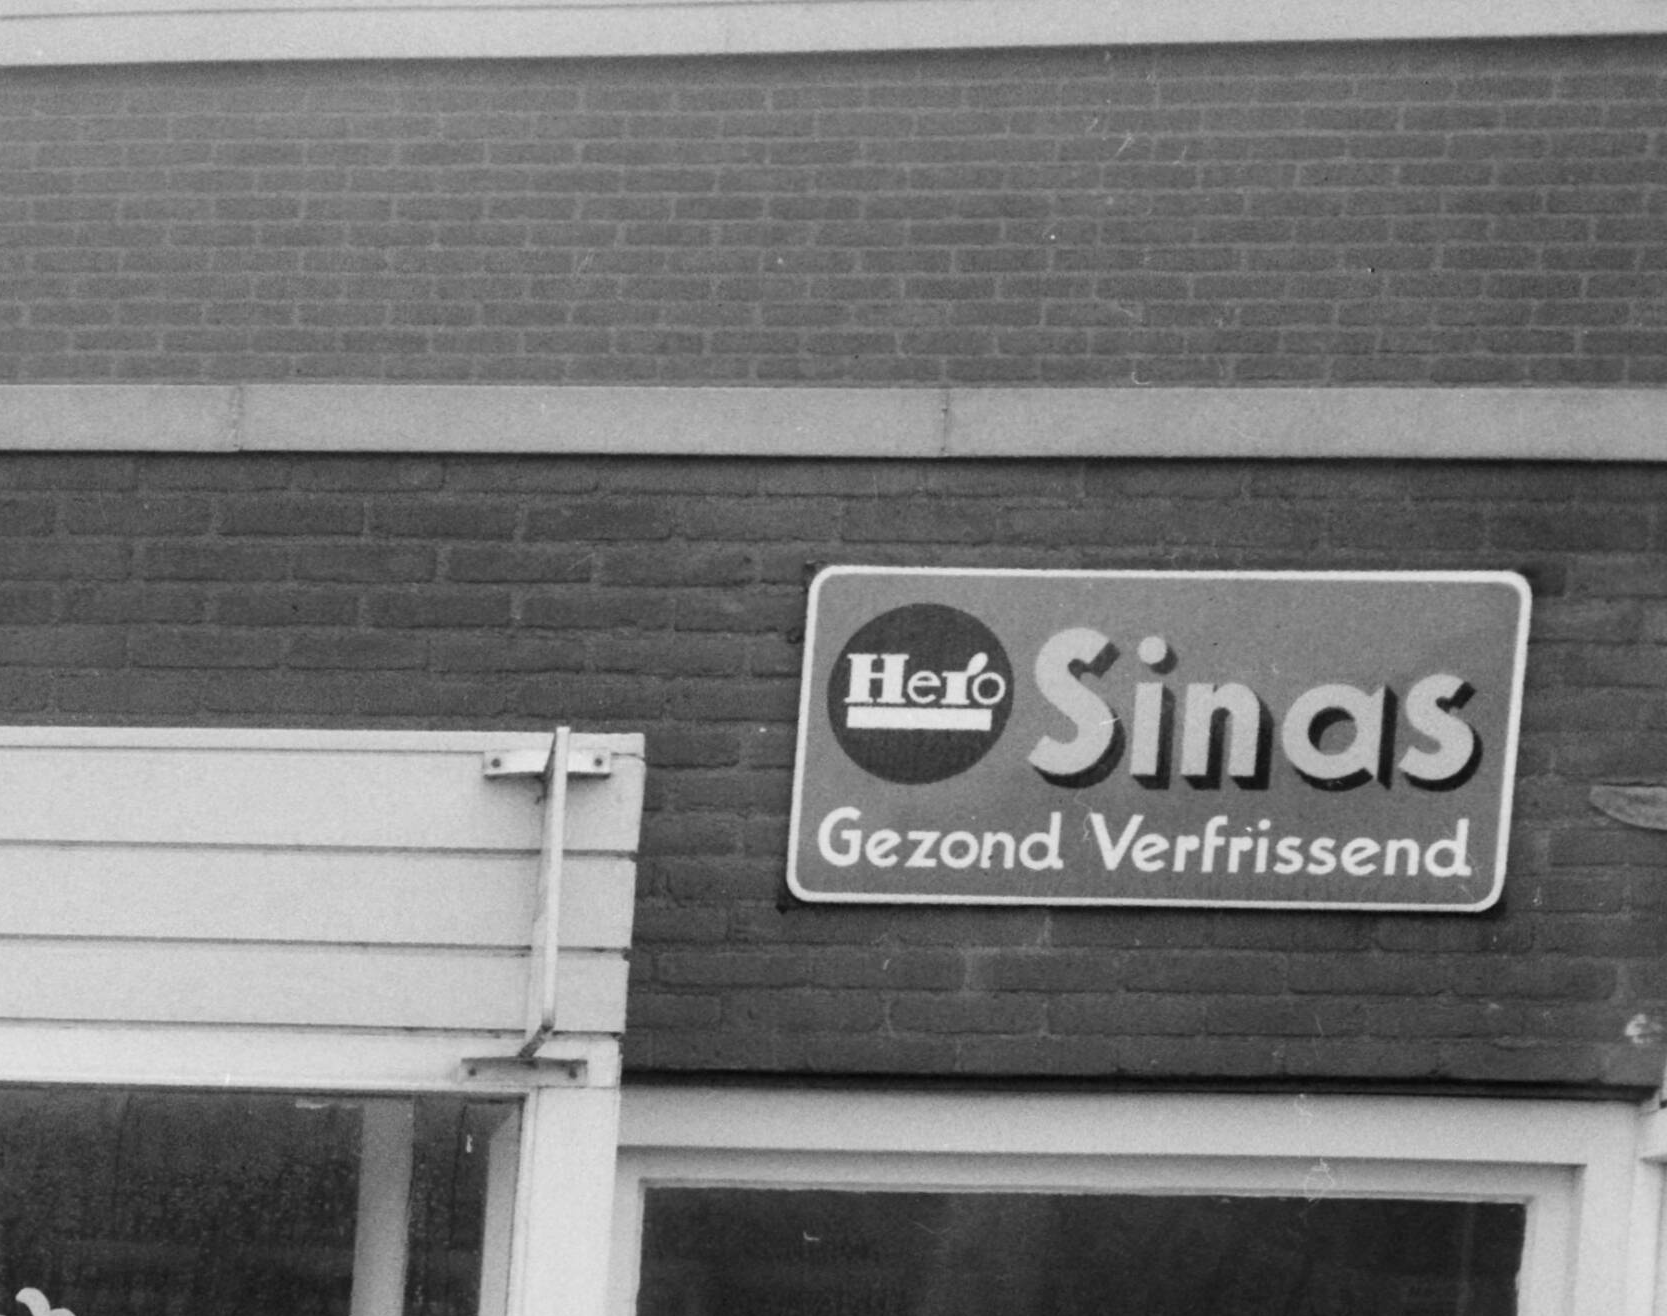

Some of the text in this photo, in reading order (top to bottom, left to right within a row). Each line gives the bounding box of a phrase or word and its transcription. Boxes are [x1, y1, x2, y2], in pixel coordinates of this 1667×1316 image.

[844, 627, 1479, 786] Hero Sinas
[817, 806, 1473, 878] Gezond Verfrissend
